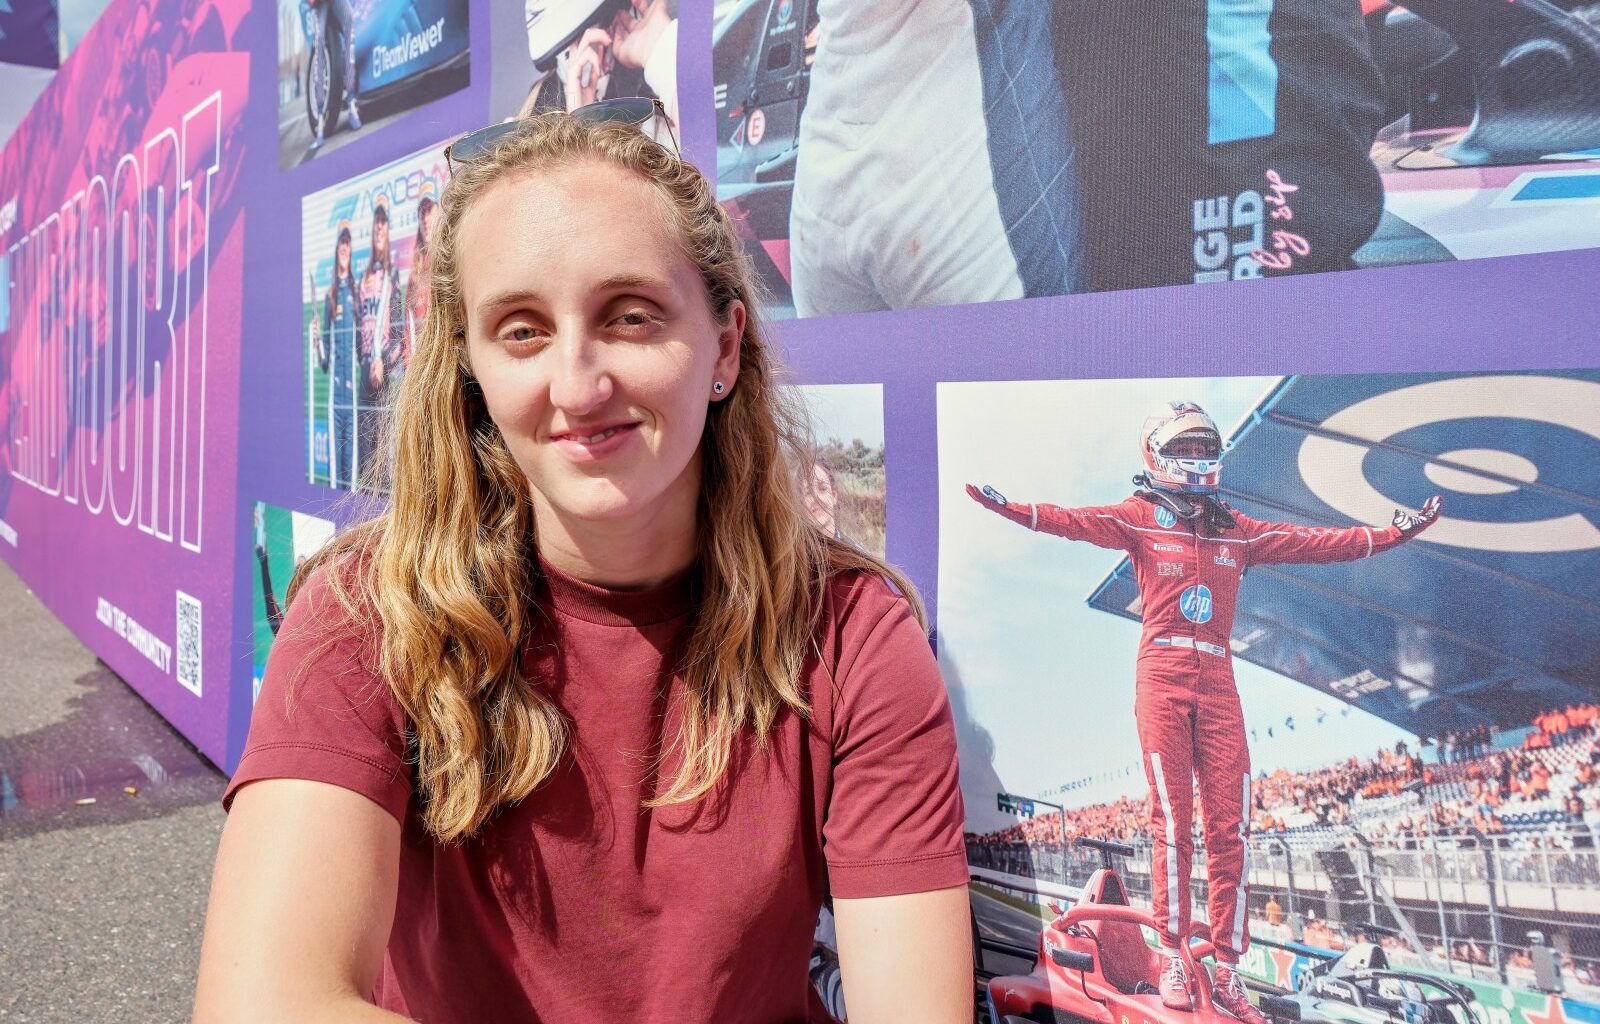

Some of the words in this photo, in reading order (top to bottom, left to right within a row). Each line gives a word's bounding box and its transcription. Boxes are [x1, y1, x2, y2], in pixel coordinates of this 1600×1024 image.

[380, 17, 445, 73] TeamViewer
[1251, 229, 1310, 270] by
[1156, 505, 1177, 528] hp
[1181, 585, 1212, 623] hp
